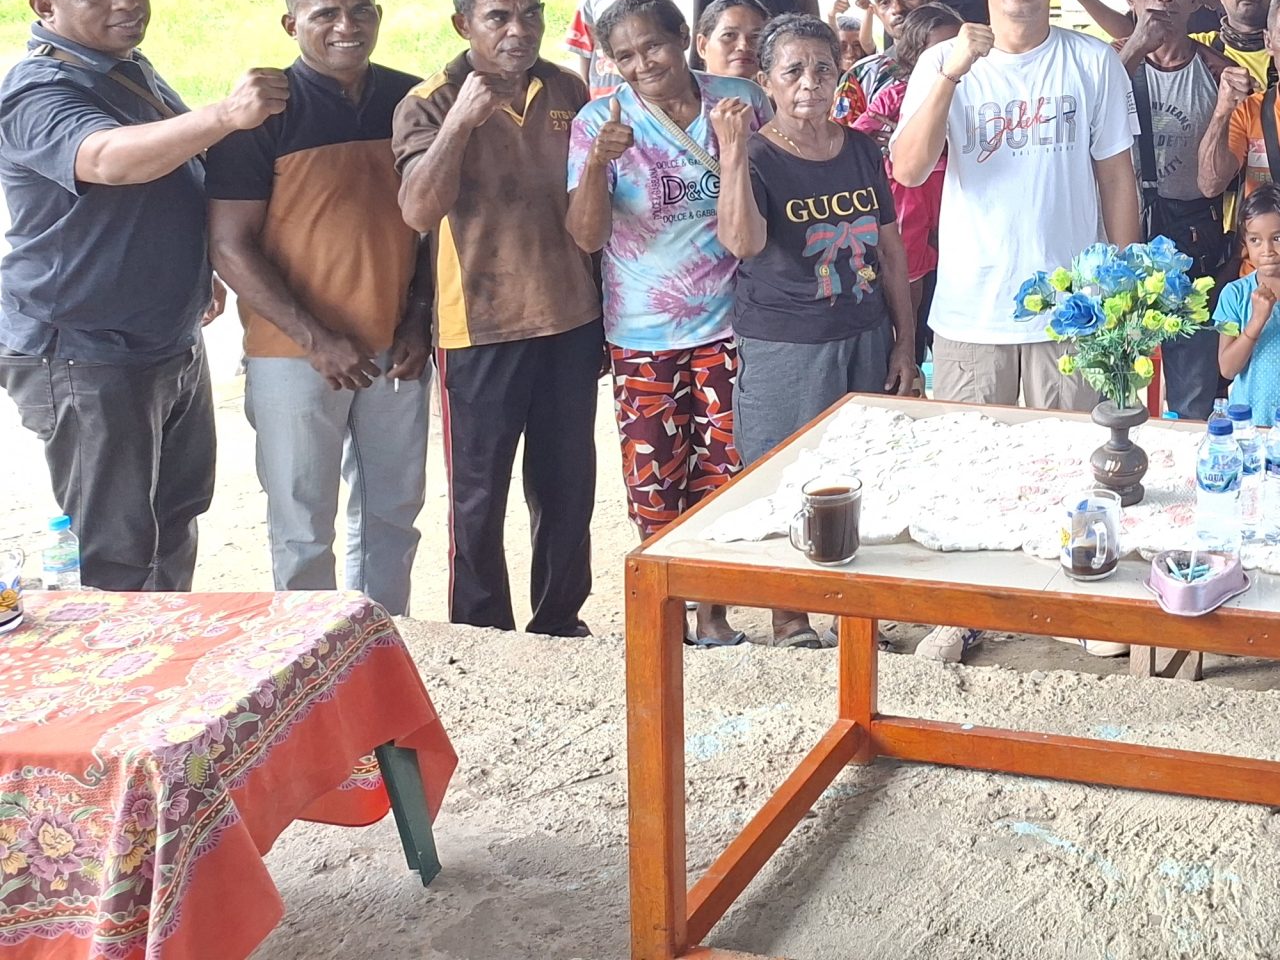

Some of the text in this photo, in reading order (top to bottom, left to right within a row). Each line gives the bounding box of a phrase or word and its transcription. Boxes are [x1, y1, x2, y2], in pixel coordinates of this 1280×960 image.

[1165, 104, 1192, 131] JEANS
[655, 159, 681, 170] DOLCE
[1157, 155, 1183, 179] LITY
[660, 170, 721, 206] D&G
[662, 212, 687, 224] DOLCE
[695, 208, 718, 219] GABB
[785, 186, 880, 223] GUCCI
[1203, 472, 1225, 483] AQUA
